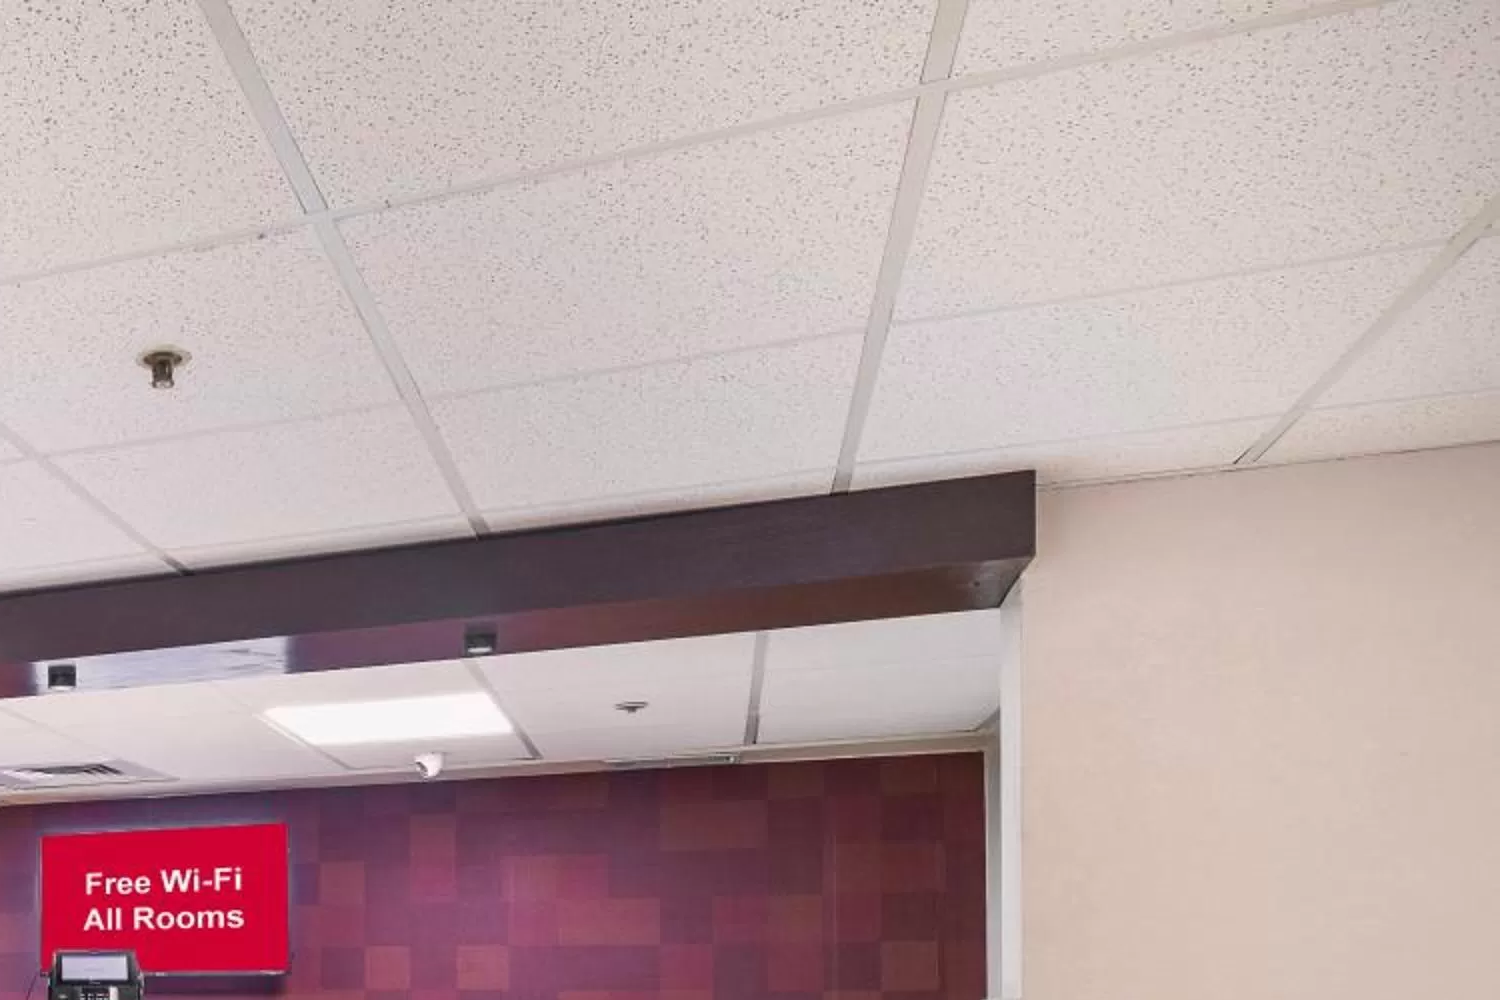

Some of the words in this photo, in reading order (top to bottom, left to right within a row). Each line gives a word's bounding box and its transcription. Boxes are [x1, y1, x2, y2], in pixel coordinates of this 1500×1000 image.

[85, 872, 151, 895] Free
[160, 867, 243, 893] Wi-Fi
[83, 907, 122, 931] All
[133, 906, 245, 930] Rooms
